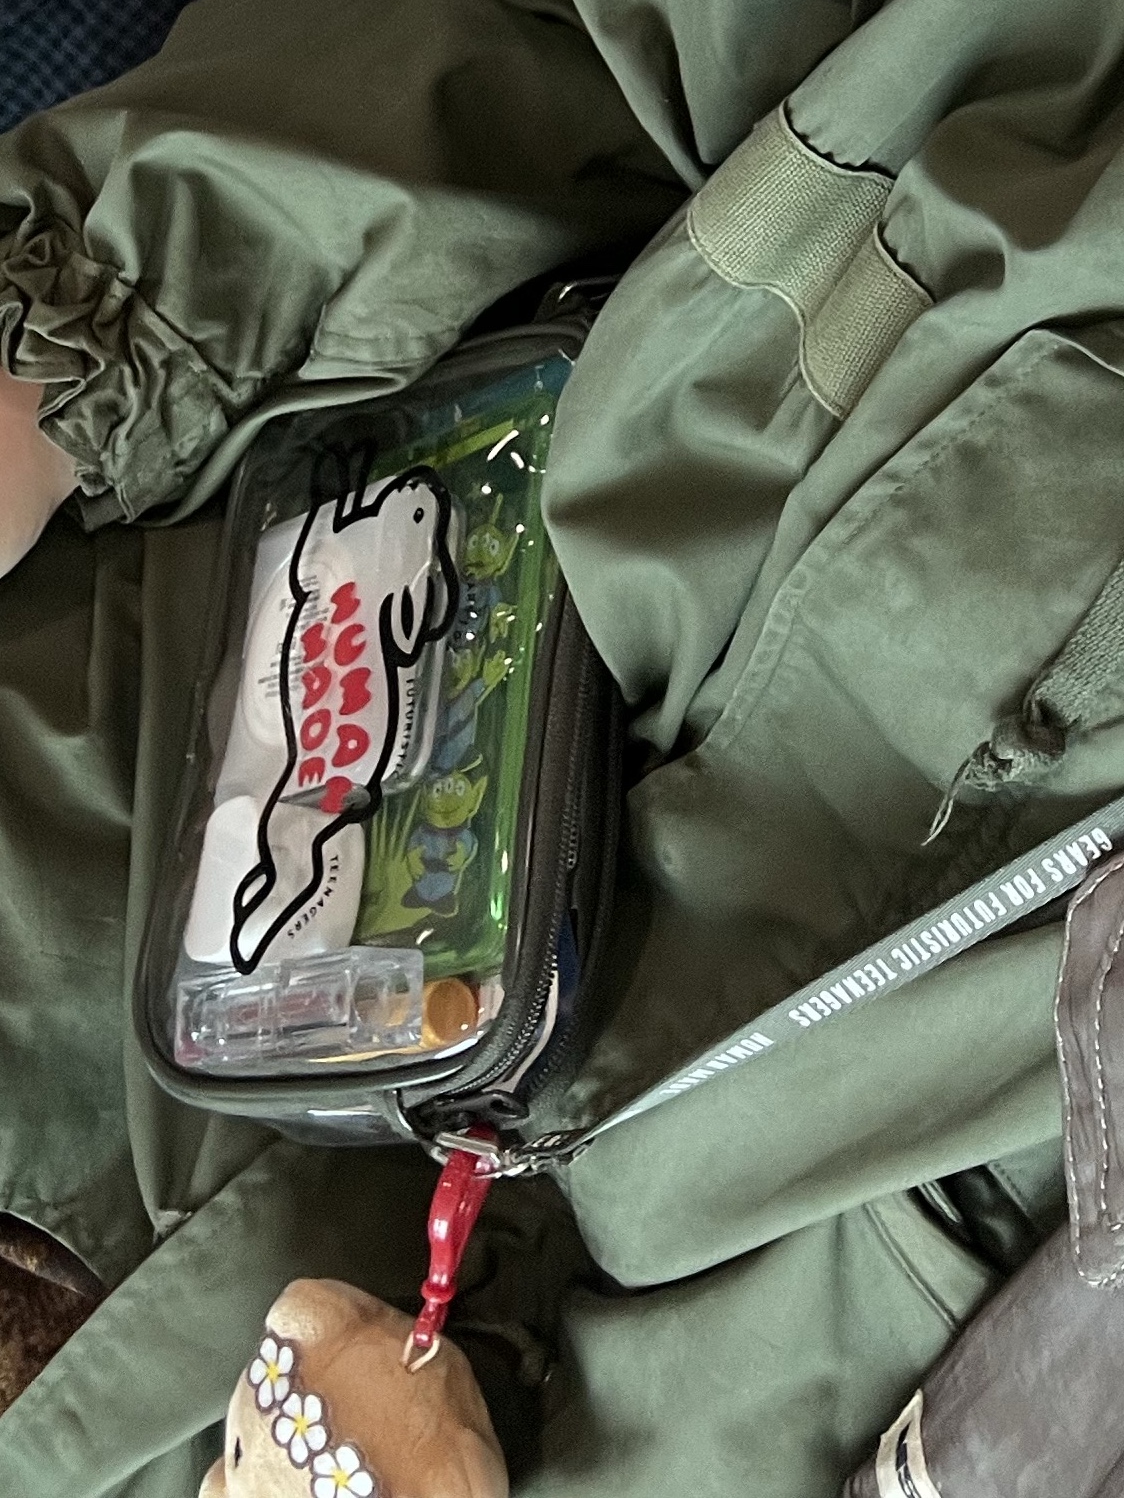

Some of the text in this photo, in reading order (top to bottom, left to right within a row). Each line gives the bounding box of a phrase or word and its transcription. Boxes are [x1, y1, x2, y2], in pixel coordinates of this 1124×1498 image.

[287, 854, 339, 939] TEENAGERS
[787, 826, 1114, 1028] GEARS FOR FUTURISTIC TEENAGERS
